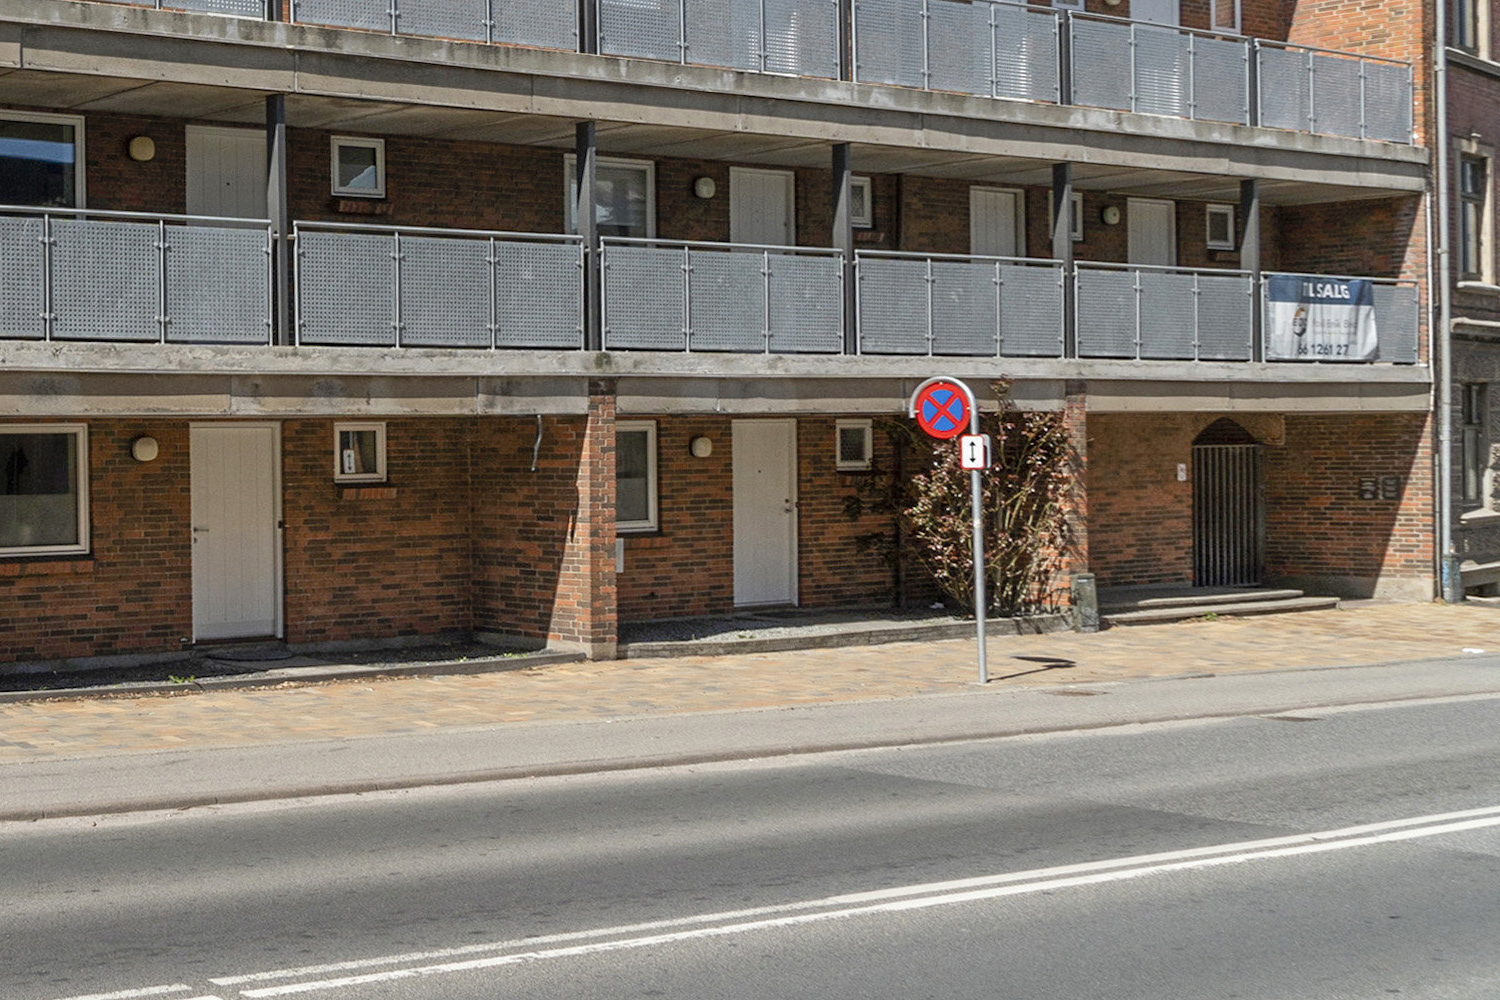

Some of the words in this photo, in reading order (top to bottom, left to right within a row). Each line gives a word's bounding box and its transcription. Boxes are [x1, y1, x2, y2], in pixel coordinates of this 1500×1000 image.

[1317, 283, 1350, 299] SALG
[1297, 344, 1308, 355] 66
[1336, 344, 1349, 355] 27
